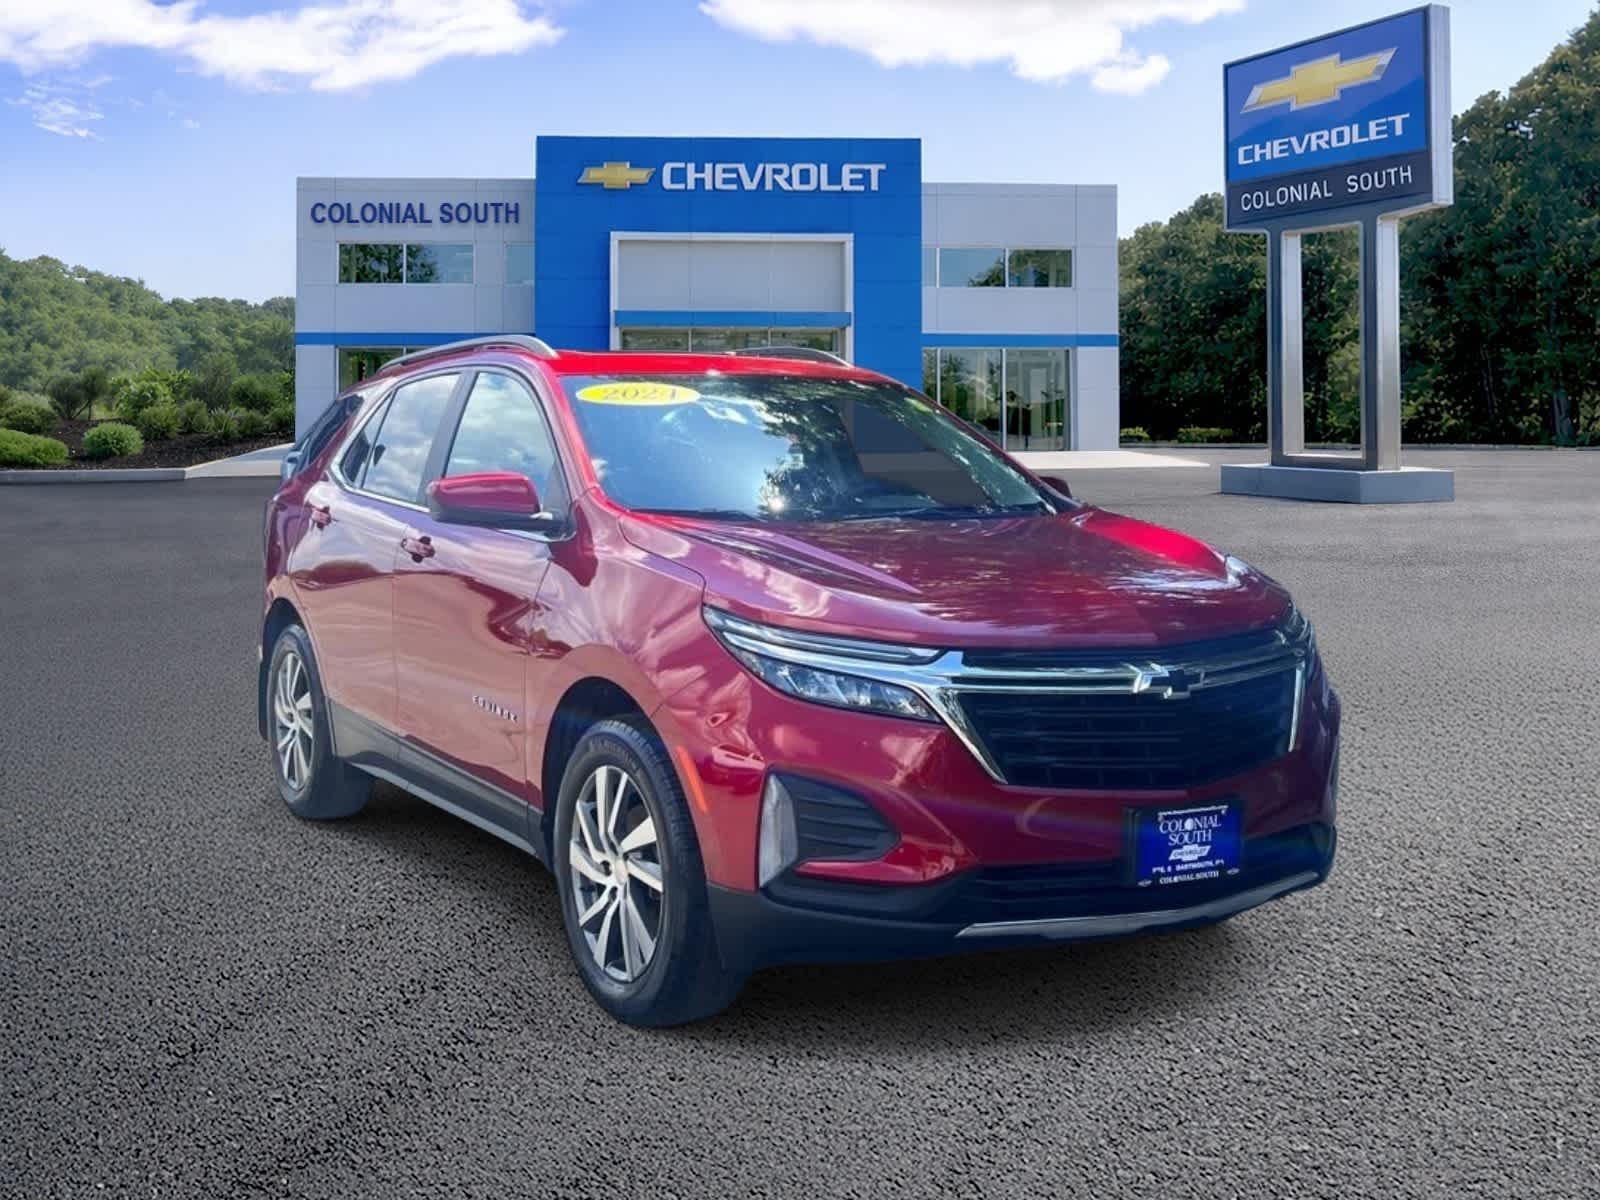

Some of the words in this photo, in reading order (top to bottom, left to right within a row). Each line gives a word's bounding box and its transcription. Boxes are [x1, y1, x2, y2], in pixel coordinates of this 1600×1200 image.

[1237, 112, 1411, 166] CHEVROLET
[661, 161, 888, 192] CHEVROLET
[1240, 179, 1334, 212] COLONIAL
[1346, 164, 1413, 194] SOUTH
[310, 201, 433, 224] COLONIAL
[439, 201, 520, 224] SOUTH
[1160, 815, 1222, 834] COLONIAL
[1168, 829, 1212, 846] SOUTH
